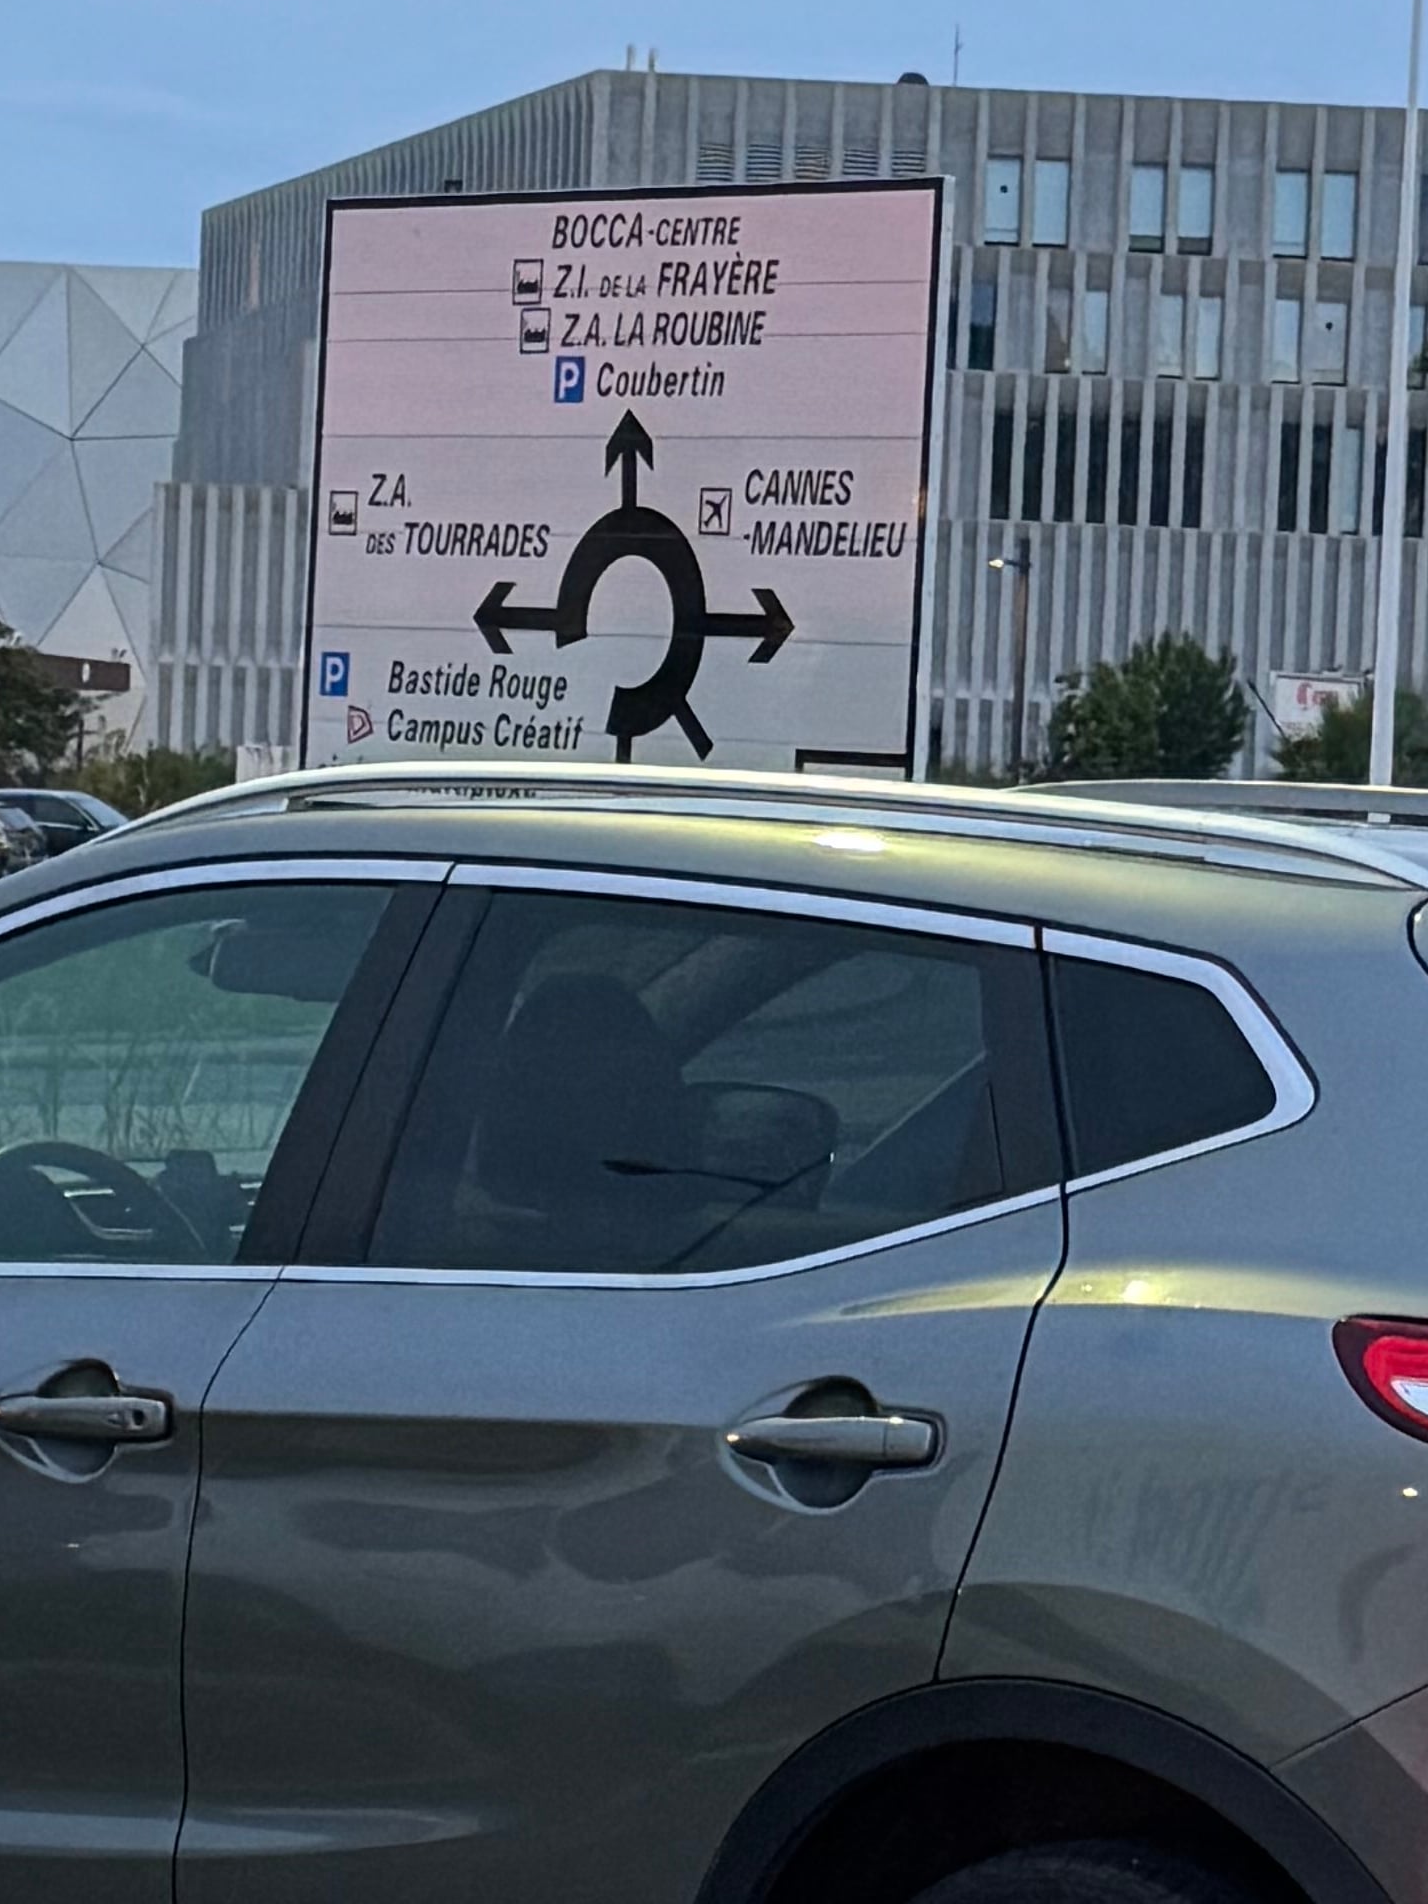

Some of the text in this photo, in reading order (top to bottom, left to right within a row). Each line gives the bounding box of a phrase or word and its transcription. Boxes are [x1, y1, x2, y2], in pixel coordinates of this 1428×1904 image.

[552, 212, 741, 249] BOCCA-CENTRE
[553, 252, 779, 298] Z.I. DE LA FRAYÈRE
[560, 311, 767, 347] Z.A. LA ROUBINE
[557, 360, 724, 400] P Coubertin
[368, 473, 411, 507] Z.A.
[745, 468, 854, 506] CANNES
[366, 521, 550, 557] DES TOURRADES
[324, 655, 567, 710] P Bastide Rouge
[387, 709, 584, 752] Campus Créatif
